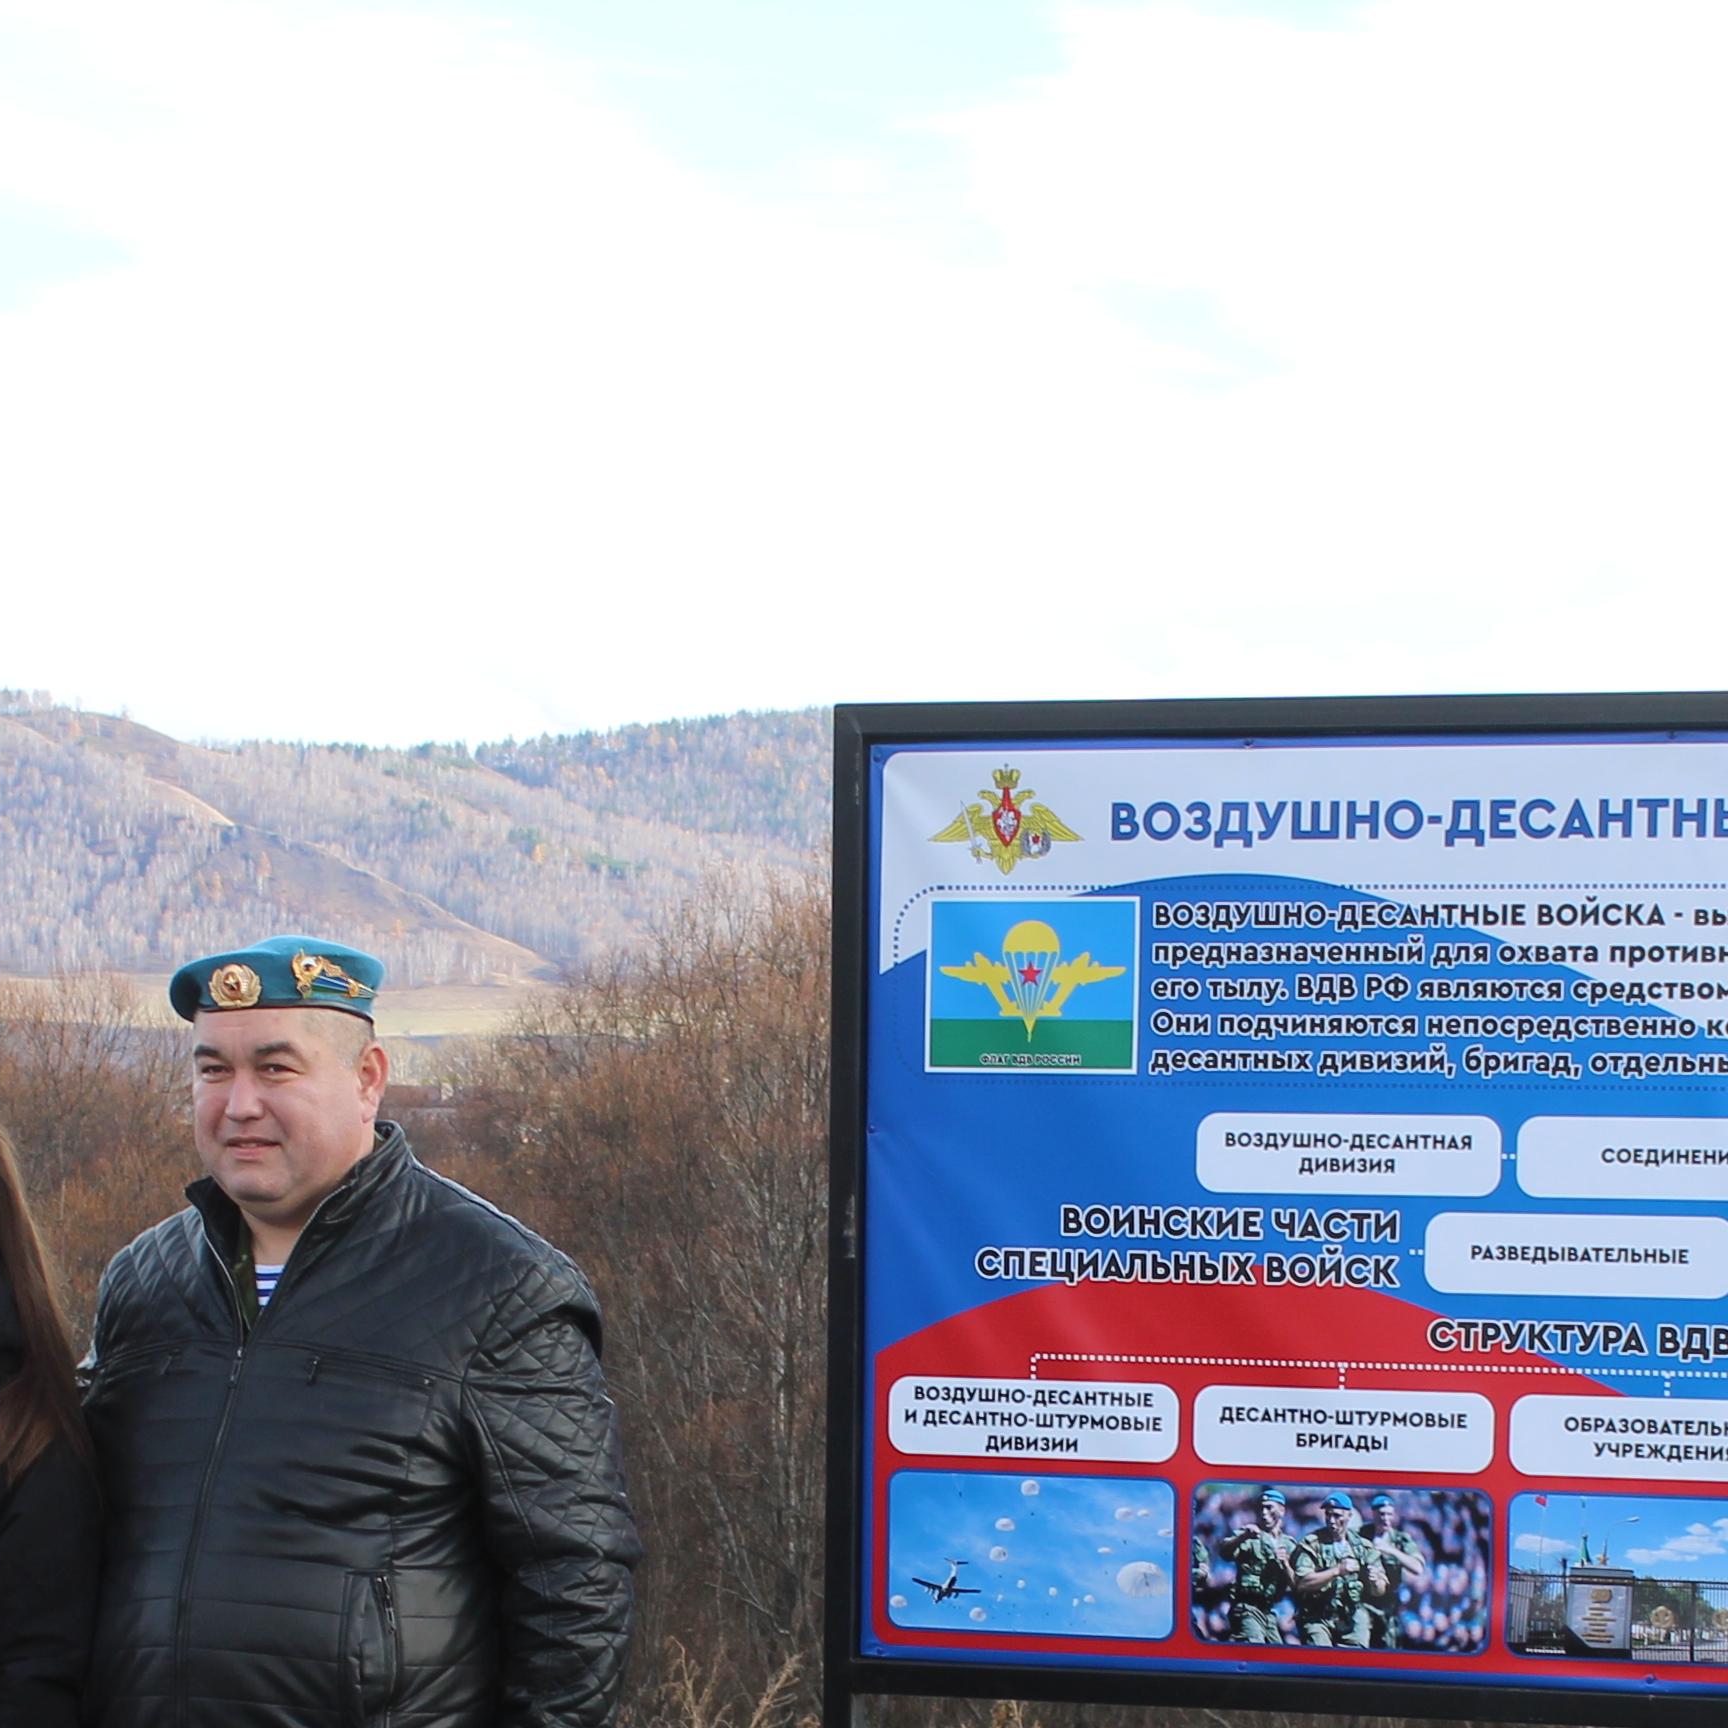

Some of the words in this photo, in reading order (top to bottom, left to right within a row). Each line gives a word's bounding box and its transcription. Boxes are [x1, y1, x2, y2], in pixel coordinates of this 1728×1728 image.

[1155, 904, 1526, 931] ВОЗДУШНО-ДЕСАНТНЫЕ
[1537, 896, 1665, 926] ВОЙСКА
[1154, 937, 1423, 967] предназначенный
[1432, 945, 1488, 967] для
[1499, 945, 1598, 963] охвата
[1153, 980, 1199, 998] его
[1208, 981, 1286, 1004] тылу.
[1297, 976, 1356, 1002] ВДВ
[1366, 976, 1409, 999] РФ
[1419, 981, 1562, 999] являются
[1152, 1011, 1209, 1033] Они
[1219, 1017, 1416, 1038] подчиняются
[1427, 1018, 1696, 1041] непосредственно
[1151, 1052, 1310, 1073] десантных
[1319, 1045, 1453, 1076] дивизий,
[1464, 1046, 1580, 1078] бригад,
[1225, 1132, 1472, 1151] ВОЗДУШНО-ДЕСАНТНАЯ
[1298, 1157, 1395, 1175] ДИВИЗИЯ
[1063, 1206, 1261, 1238] ВОИНСКИЕ
[1274, 1211, 1397, 1240] ЧАСТИ
[977, 1249, 1252, 1285] СПЕЦИАЛЬНЫХ
[1266, 1247, 1396, 1285] ВОЙСК
[1471, 1245, 1688, 1264] РАЗВЕДЫВАТЕЛЬНЫЕ
[1430, 1321, 1645, 1353] СТРУКТУРА
[914, 1385, 1153, 1412] ВОЗДУШНО-ДЕСАНТНЫЕ
[904, 1409, 917, 1423] И
[922, 1409, 1162, 1432] ДЕСАНТНО-ШТУРМОВЫЕ
[1219, 1406, 1466, 1429] ДЕСАНТНО-ШТУРМОВЫЕ
[985, 1435, 1078, 1453] ДИВИЗИИ
[1296, 1432, 1388, 1453] БРИГАДЫ
